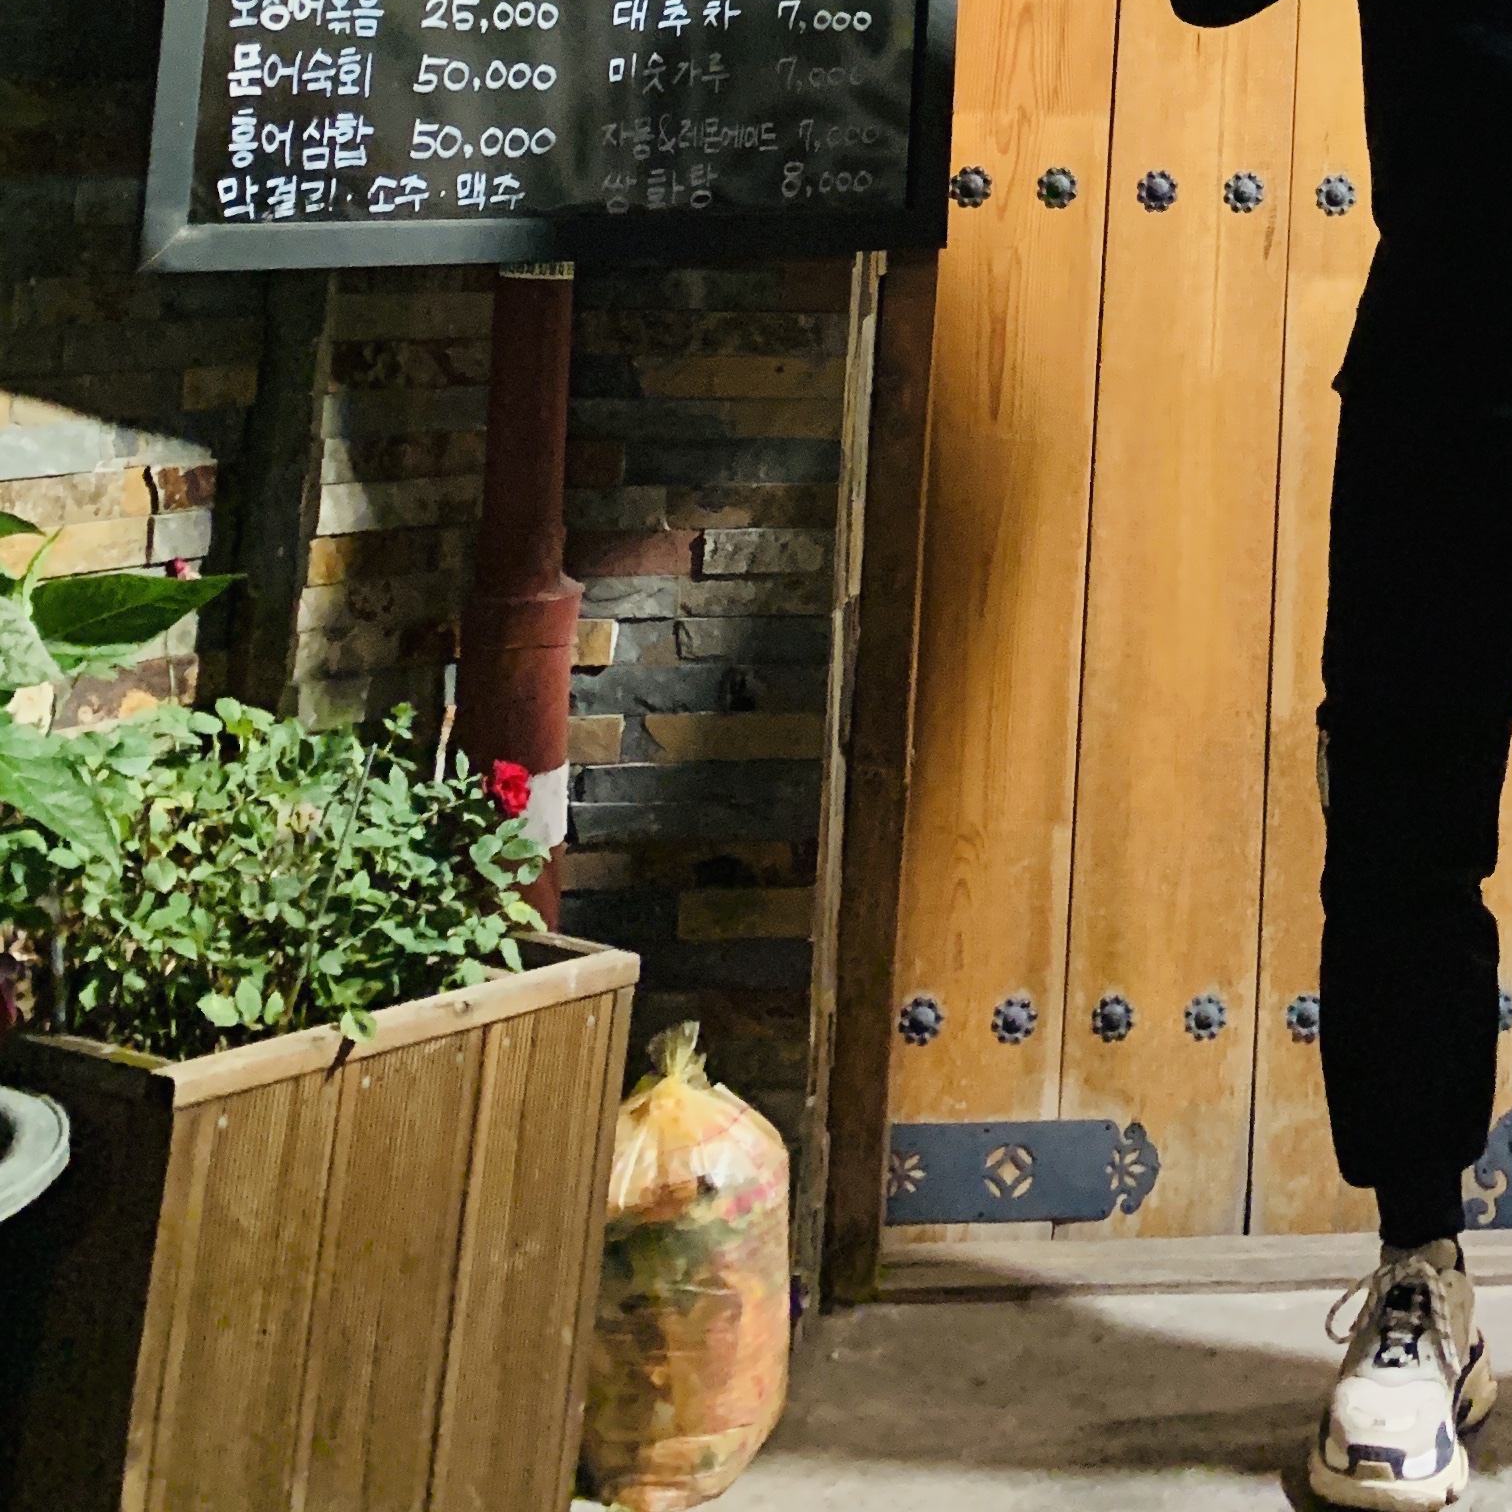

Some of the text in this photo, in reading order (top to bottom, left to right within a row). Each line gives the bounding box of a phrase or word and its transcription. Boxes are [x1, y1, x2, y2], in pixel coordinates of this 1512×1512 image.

[777, 0, 873, 34] 7,000
[227, 42, 557, 98] 문어숙회 50,000
[409, 118, 556, 160] 50,000
[799, 118, 880, 153] 7,000
[781, 160, 873, 199] 8,000
